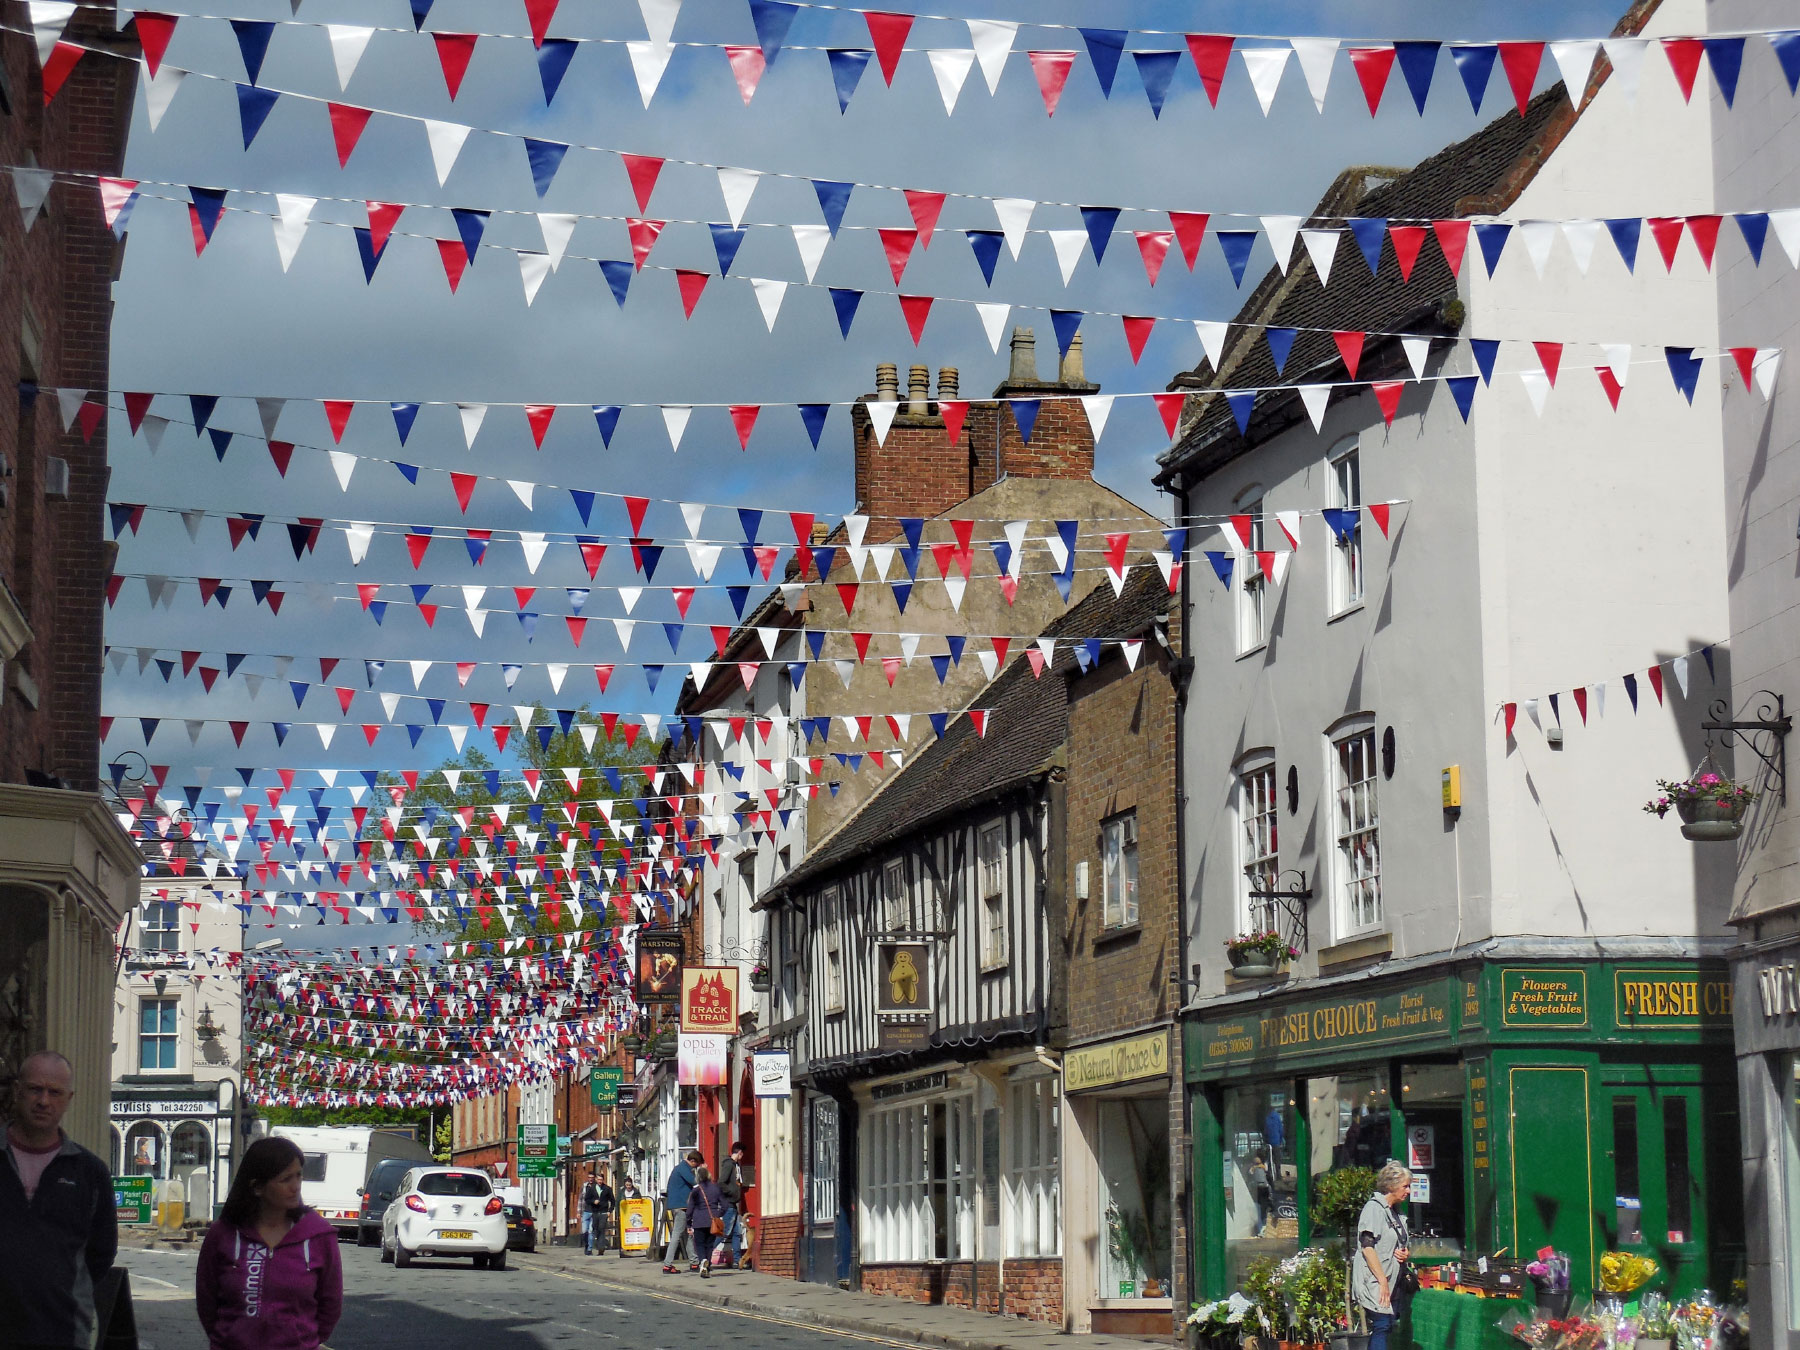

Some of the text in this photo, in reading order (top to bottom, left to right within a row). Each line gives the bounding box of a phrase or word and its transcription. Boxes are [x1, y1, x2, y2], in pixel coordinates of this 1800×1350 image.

[1522, 980, 1567, 990] Flowers
[1759, 964, 1800, 1017] WI
[1400, 993, 1424, 1009] Florist
[1511, 992, 1578, 1002] Fresh Fruit
[1624, 981, 1699, 1015] FRESH
[691, 1006, 728, 1014] TRACK
[1465, 1000, 1479, 1016] 1993
[1508, 1003, 1582, 1016] & Vegetables
[1382, 1012, 1400, 1028] Fresh
[1402, 1010, 1420, 1025] Fruit
[1422, 1007, 1428, 1022] &
[1260, 1001, 1377, 1048] FRESH CHOICE
[683, 1038, 715, 1053] opus
[696, 1047, 722, 1058] gallery
[755, 1061, 789, 1075] Cob Stop
[1079, 1043, 1149, 1081] Natural Choice
[594, 1071, 621, 1080] Gallery
[604, 1082, 610, 1090] &
[597, 1091, 616, 1101] Café
[113, 1102, 204, 1113] stylists Tel.342250
[117, 1210, 138, 1218] ovedale
[243, 1260, 262, 1316] animal
